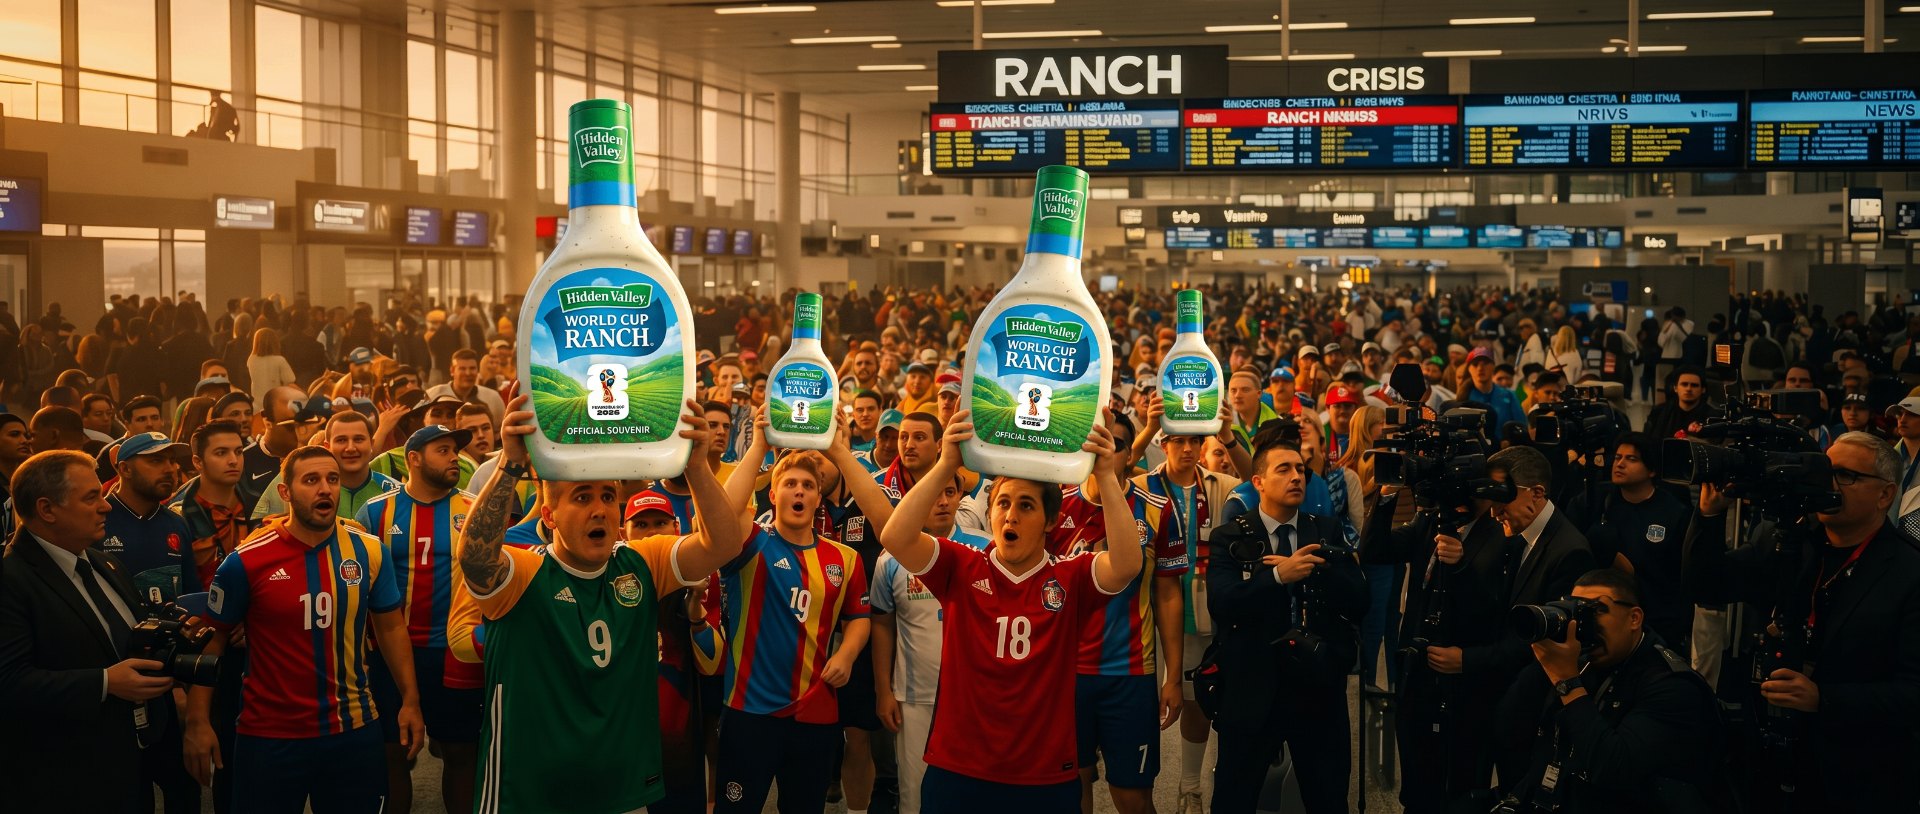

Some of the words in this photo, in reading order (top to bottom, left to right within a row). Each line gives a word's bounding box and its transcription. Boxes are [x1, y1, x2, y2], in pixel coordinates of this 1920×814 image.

[995, 54, 1182, 97] RANCH
[1327, 66, 1425, 92] CRISIS
[1267, 111, 1320, 124] RANCH
[1865, 104, 1916, 117] NEWS
[580, 132, 623, 146] Hidden
[1043, 192, 1079, 207] Hidden
[566, 291, 609, 305] Hidden
[564, 314, 617, 327] WORLD
[620, 313, 649, 326] CUP
[1011, 321, 1047, 334] Hidden
[1007, 339, 1051, 354] WORLD
[1052, 345, 1077, 357] CUP
[566, 426, 606, 435] OFFICIAL
[606, 425, 651, 434] SOUVENIR
[994, 430, 1027, 441] OFFICIAL
[1027, 435, 1064, 446] SOUVENIR
[417, 536, 431, 566] 7
[299, 591, 333, 631] 19
[789, 586, 812, 623] 19
[587, 619, 612, 668] 9
[996, 615, 1032, 660] 18
